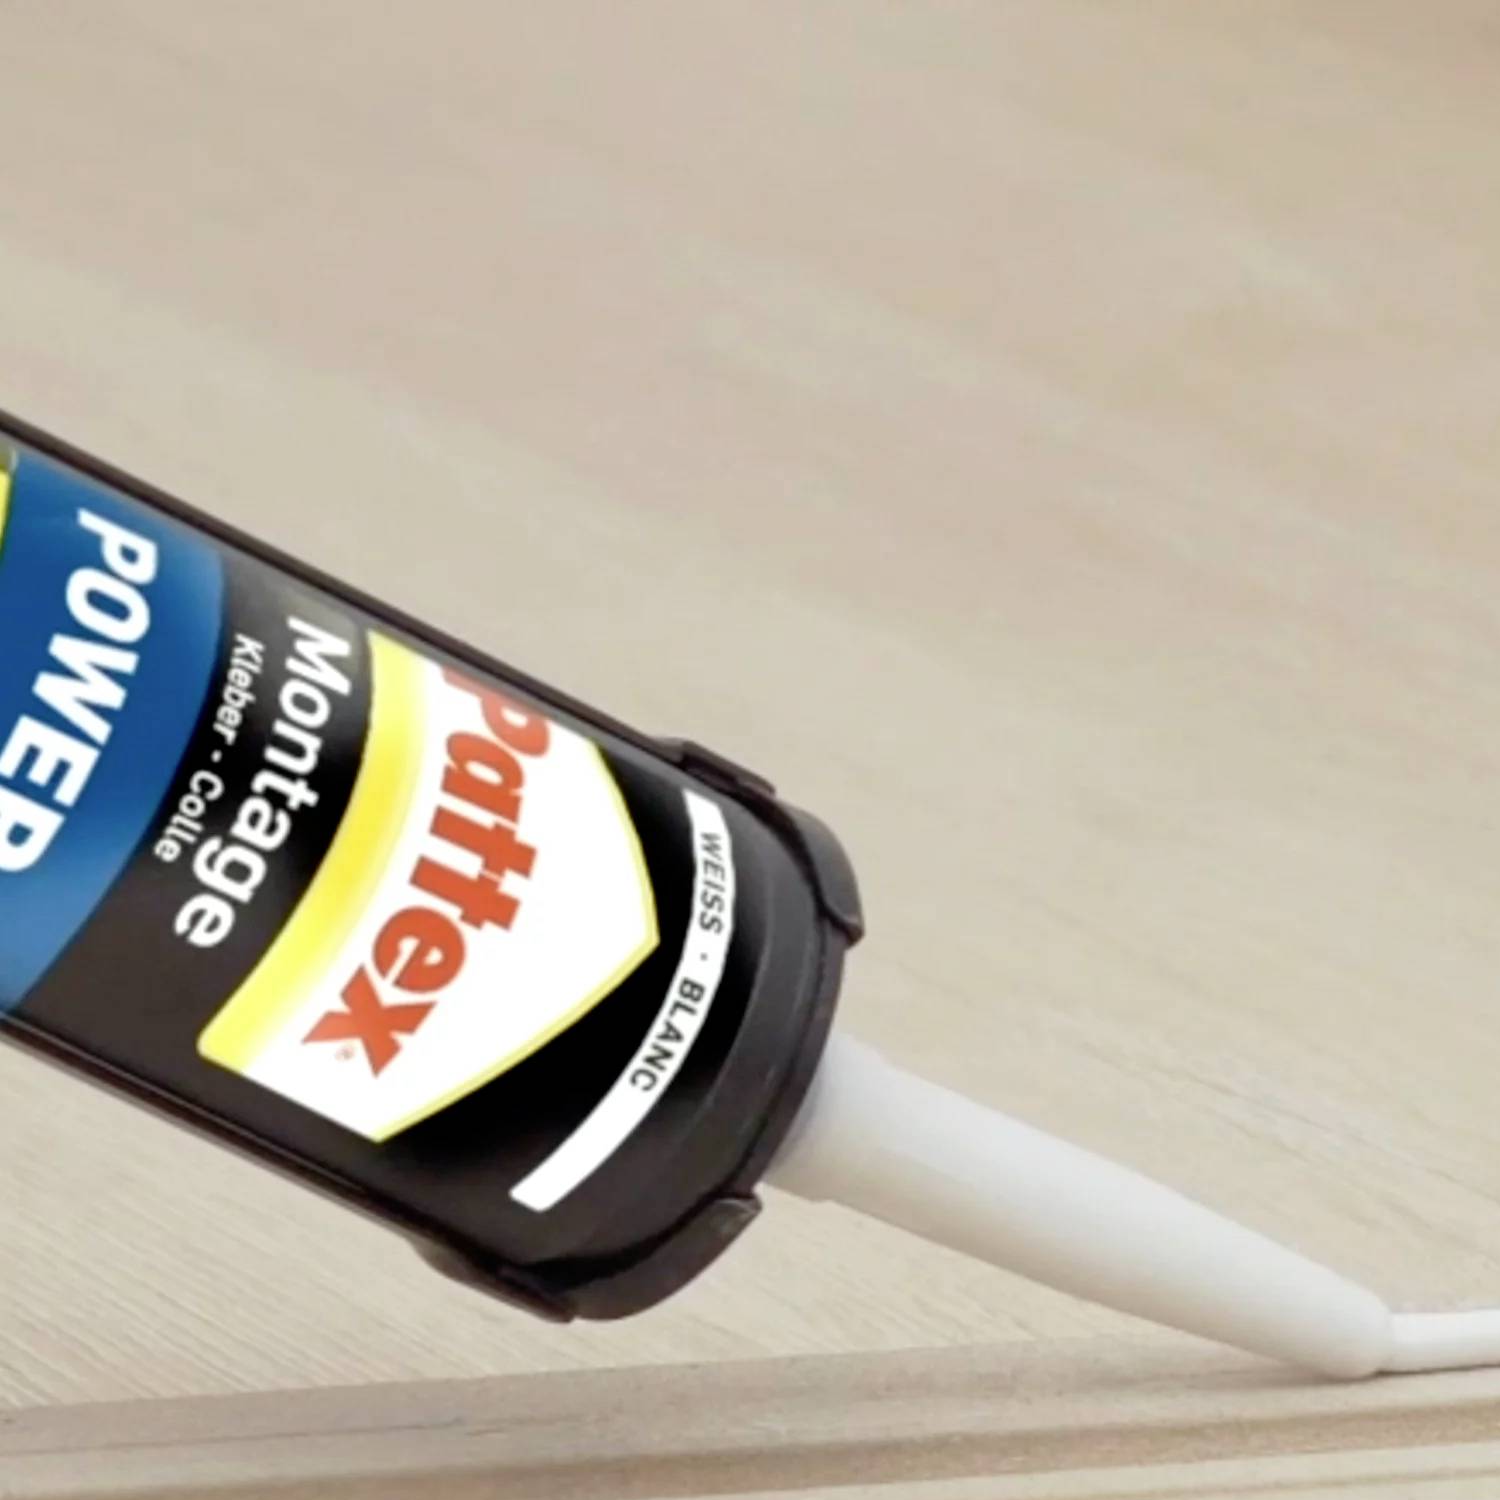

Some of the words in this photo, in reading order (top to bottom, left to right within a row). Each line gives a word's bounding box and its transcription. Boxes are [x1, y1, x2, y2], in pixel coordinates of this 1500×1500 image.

[212, 632, 265, 746] Kleber
[155, 769, 225, 862] Colle
[174, 615, 352, 947] Montage
[699, 831, 726, 935] WEISS
[629, 976, 707, 1092] BLANC
